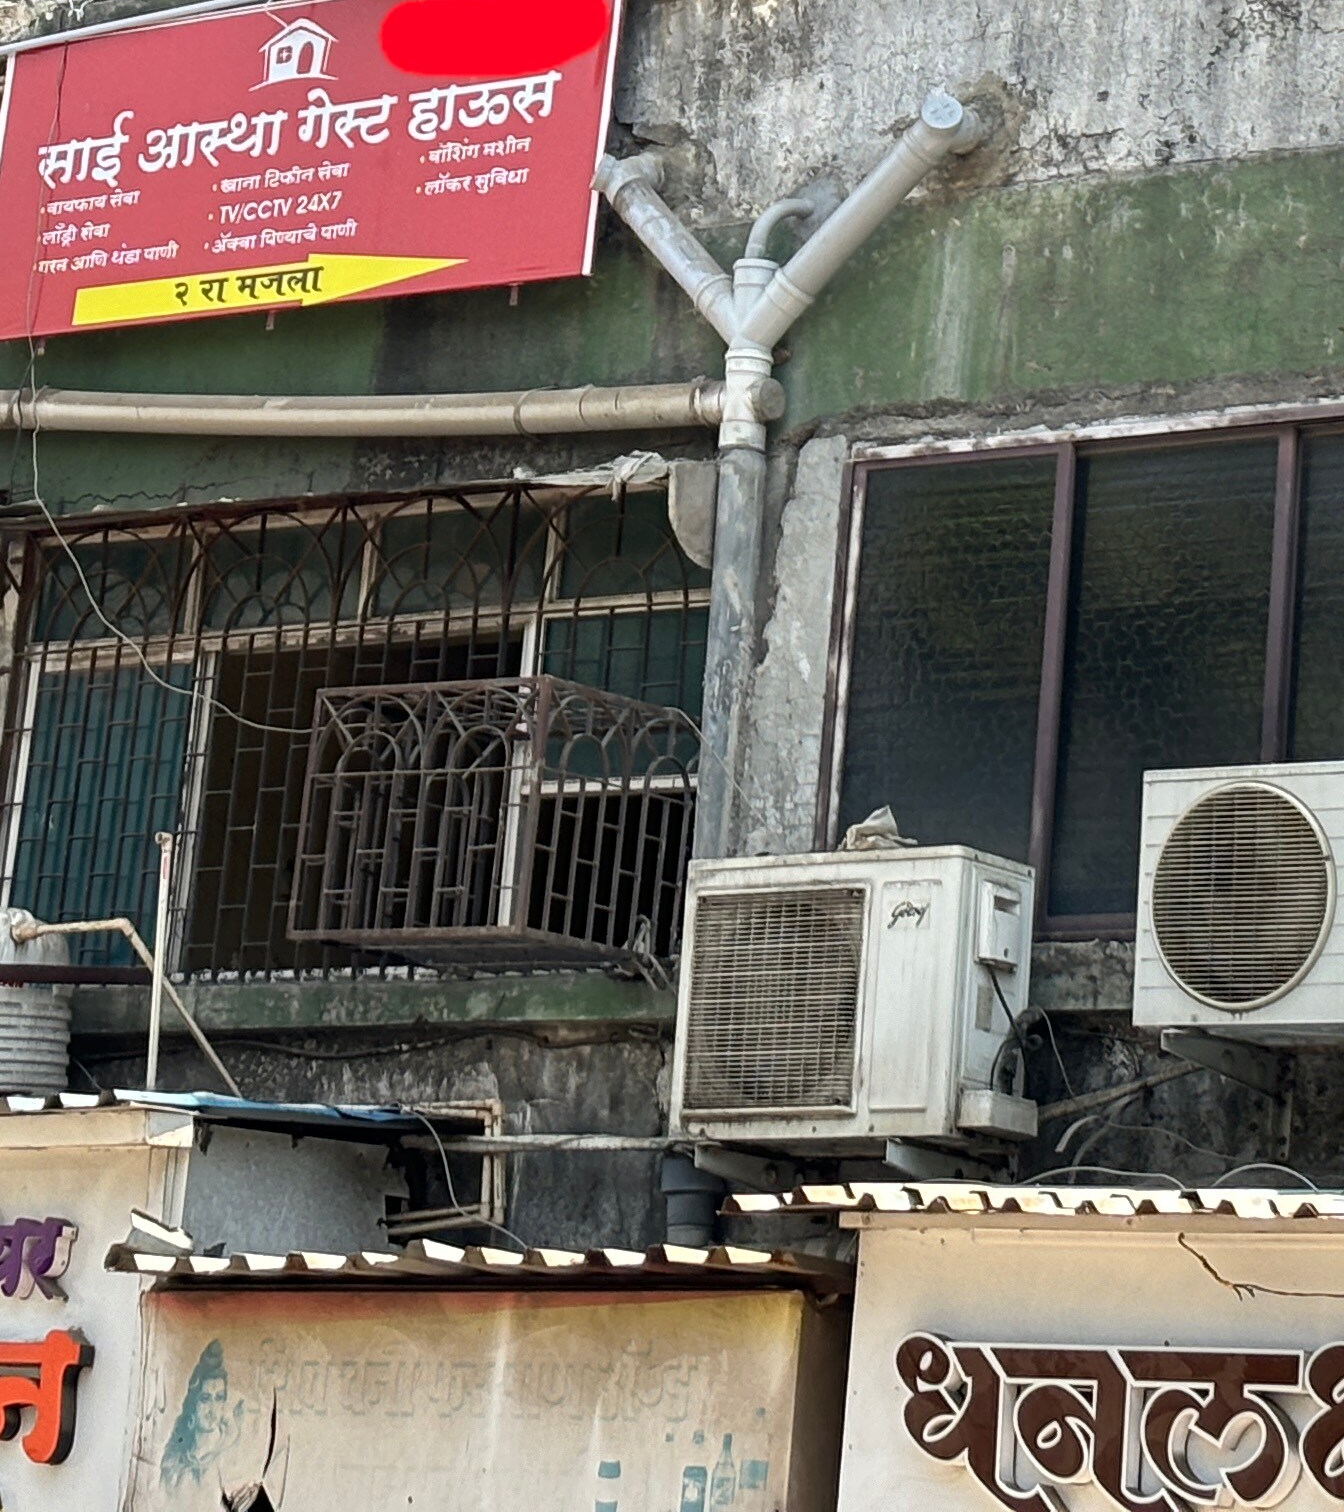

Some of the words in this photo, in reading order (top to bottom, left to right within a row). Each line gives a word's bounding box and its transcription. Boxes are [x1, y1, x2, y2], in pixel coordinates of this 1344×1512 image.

[38, 110, 134, 189] साई
[138, 109, 288, 173] आस्था
[298, 88, 397, 150] गेस्ट
[407, 70, 562, 141] हाऊस
[483, 135, 531, 156] मशीन
[220, 174, 261, 193] खाना
[318, 161, 351, 182] सेवा
[424, 172, 473, 195] लॉकर
[475, 167, 530, 194] सुविधा
[46, 194, 108, 215] वायफाय
[109, 188, 141, 208] सेवा
[219, 197, 293, 224] TV/CCTV
[296, 190, 343, 215] 24X7
[320, 218, 359, 239] पाणी
[70, 249, 108, 271] आणि
[143, 240, 180, 260] पाणी
[174, 281, 189, 306] २
[199, 278, 229, 303] रा
[235, 266, 324, 299] मजला
